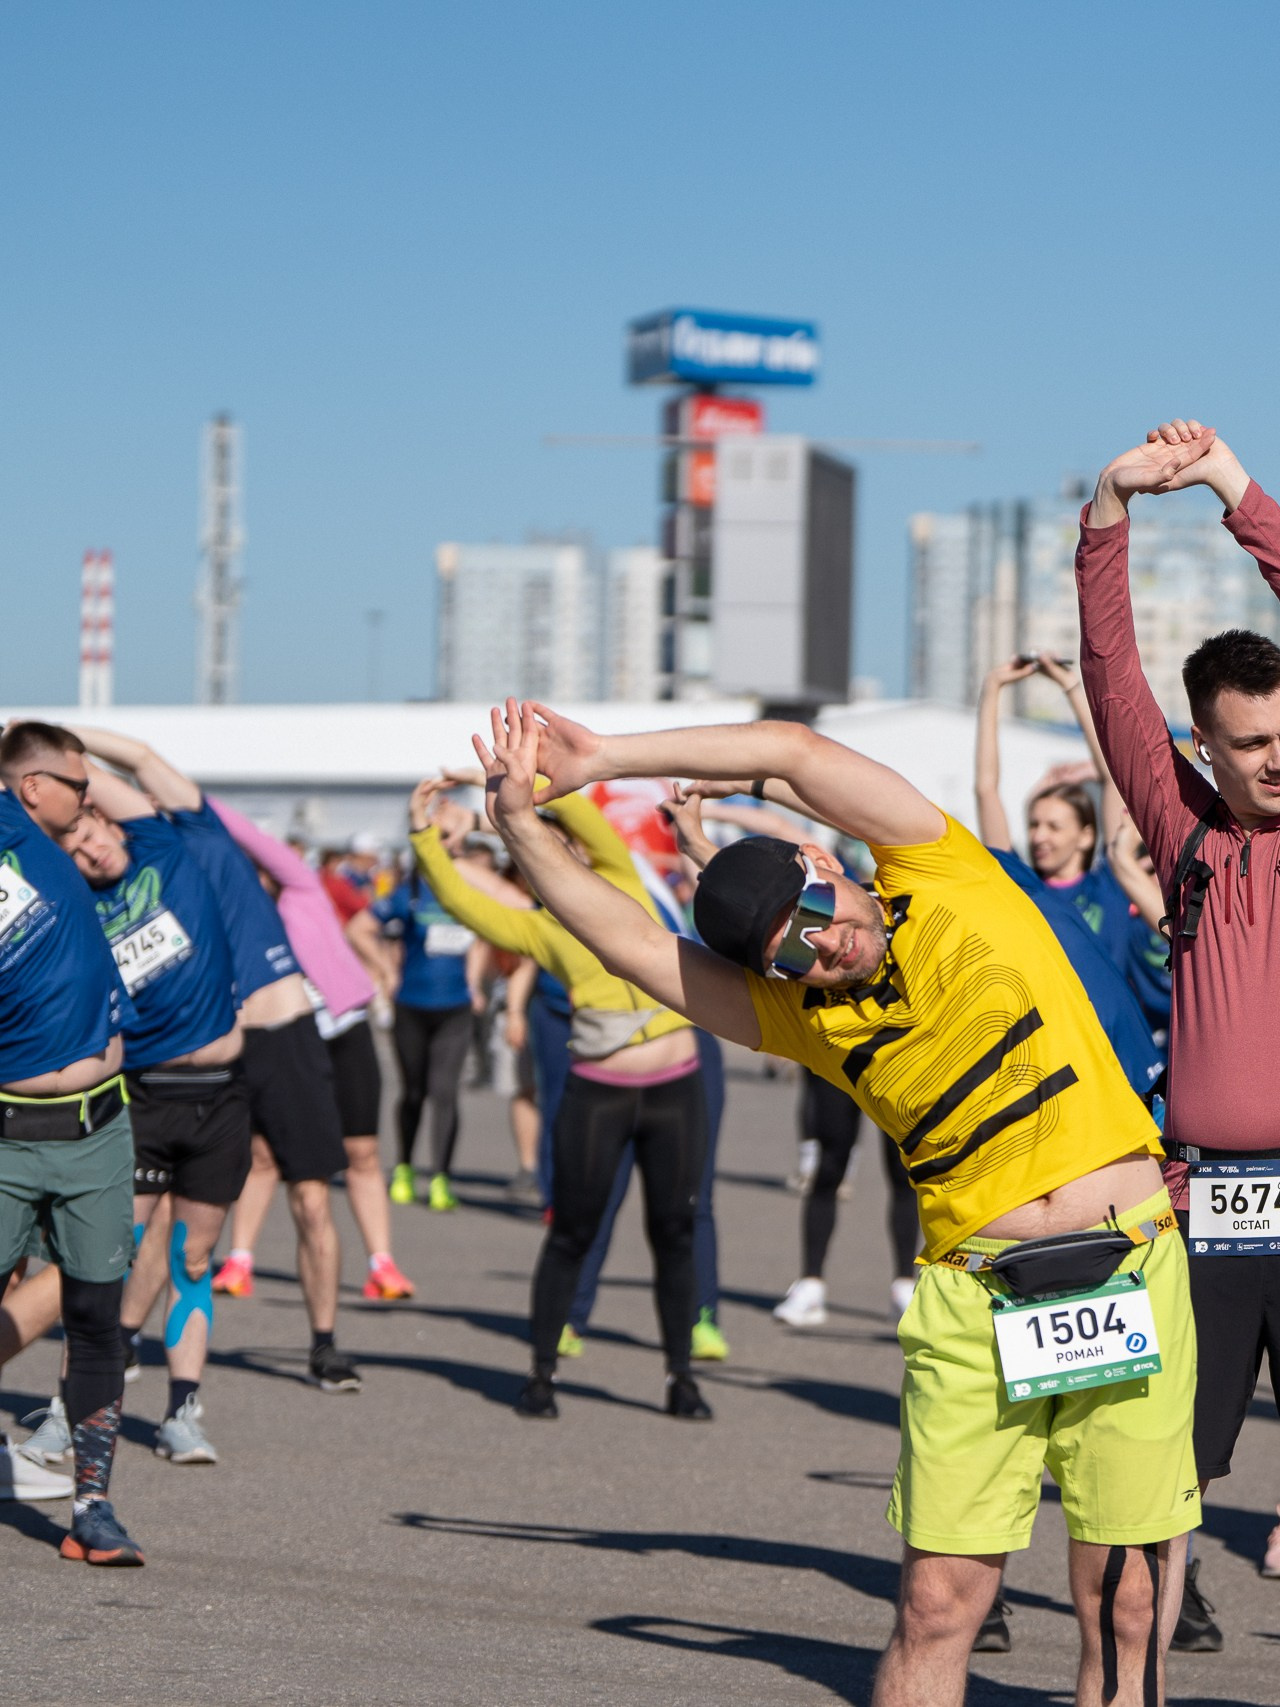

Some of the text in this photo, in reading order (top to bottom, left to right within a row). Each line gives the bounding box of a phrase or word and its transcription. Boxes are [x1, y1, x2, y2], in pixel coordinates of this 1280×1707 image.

[116, 924, 165, 968] 4745
[1232, 1219, 1270, 1231] ОСТАП
[1026, 1302, 1126, 1349] 1504
[1056, 1345, 1105, 1364] РОМАН
